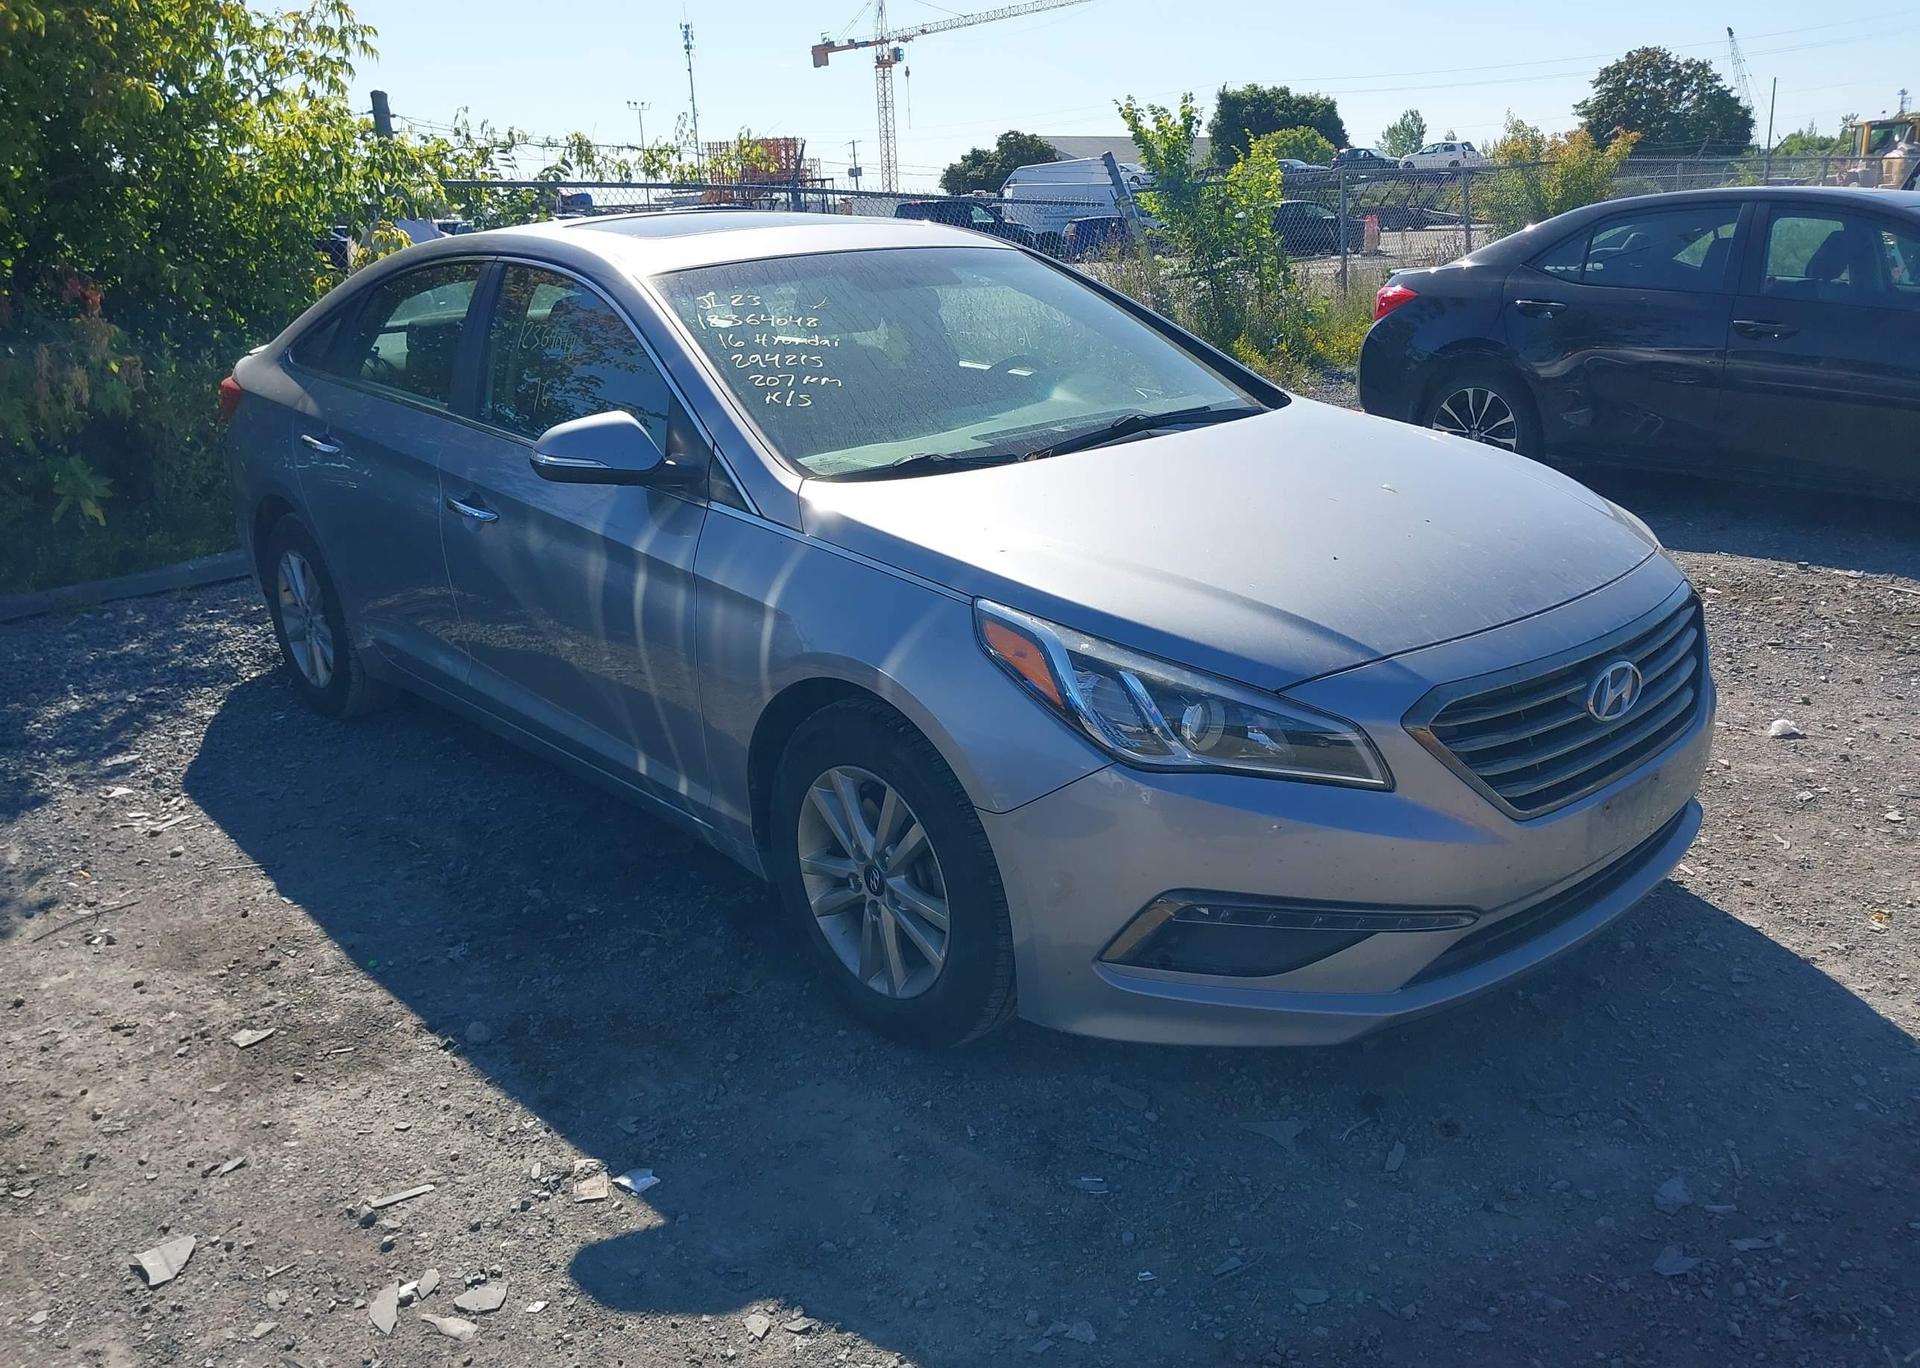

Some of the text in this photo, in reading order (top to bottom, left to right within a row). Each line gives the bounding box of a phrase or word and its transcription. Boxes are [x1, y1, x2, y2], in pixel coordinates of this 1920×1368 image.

[730, 294, 761, 306] 23
[718, 333, 745, 350] 16
[748, 374, 795, 387] 207
